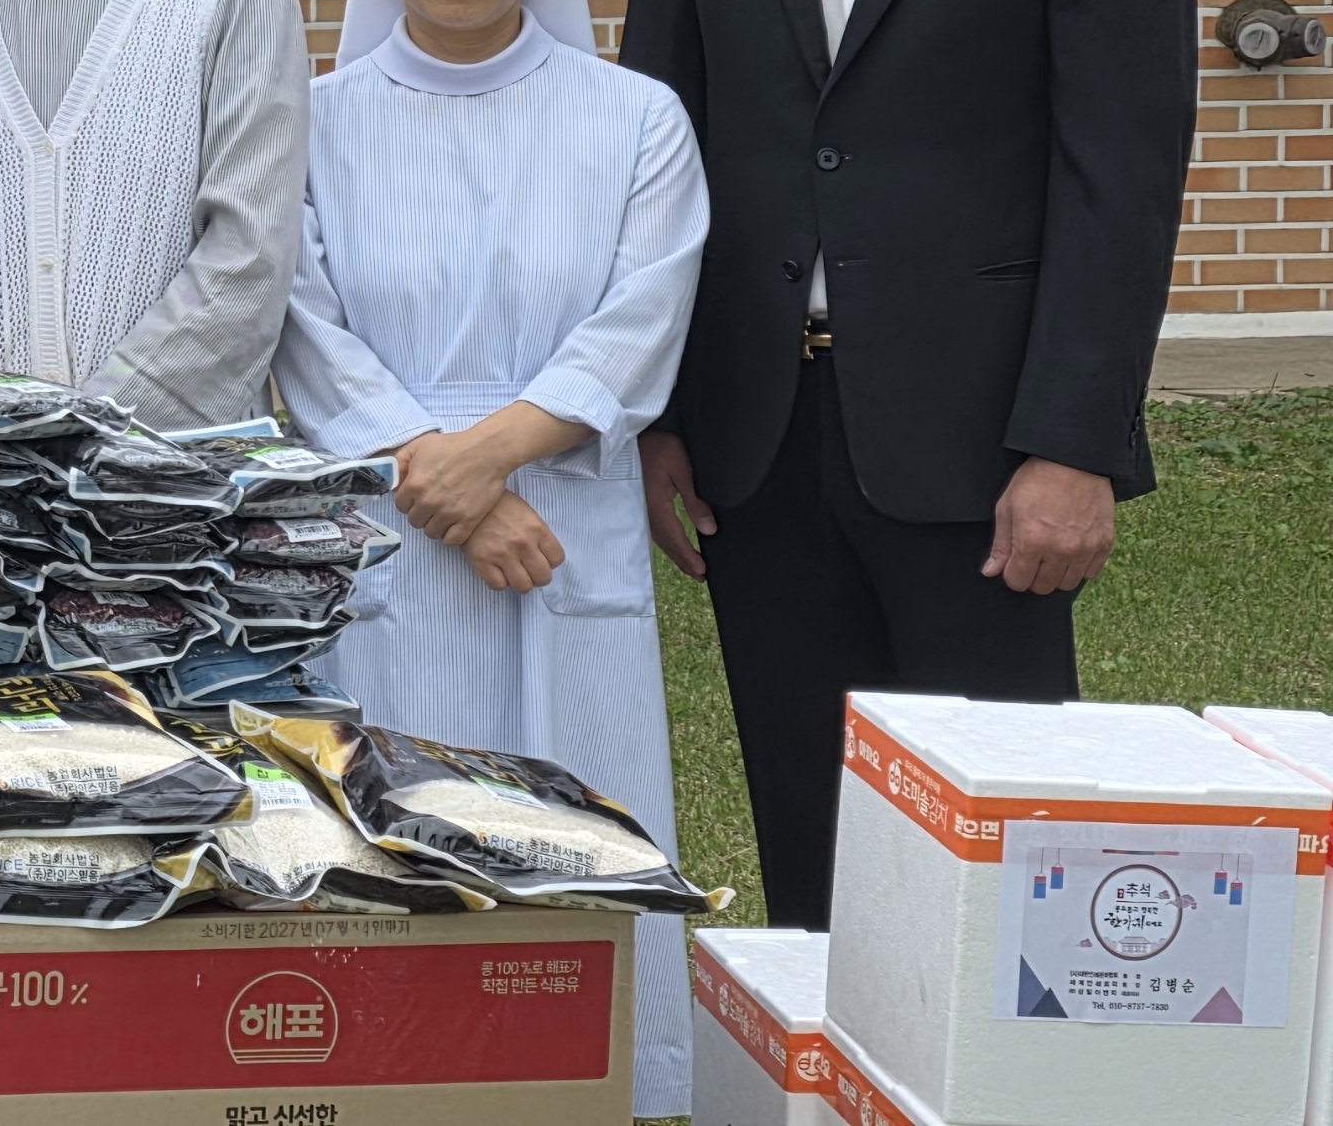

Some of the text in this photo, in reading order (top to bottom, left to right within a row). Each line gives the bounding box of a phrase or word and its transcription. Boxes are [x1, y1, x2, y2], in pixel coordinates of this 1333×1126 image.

[47, 765, 118, 781] 농업회사법인
[11, 776, 44, 789] RICE
[490, 834, 525, 854] RICE
[529, 837, 595, 864] 농업회사법인
[28, 851, 101, 868] 농업회사법인
[1125, 883, 1151, 897] 추석
[546, 959, 582, 975] 해표가
[482, 976, 579, 994] 직접 만든 식용유
[239, 1003, 325, 1040] 해표
